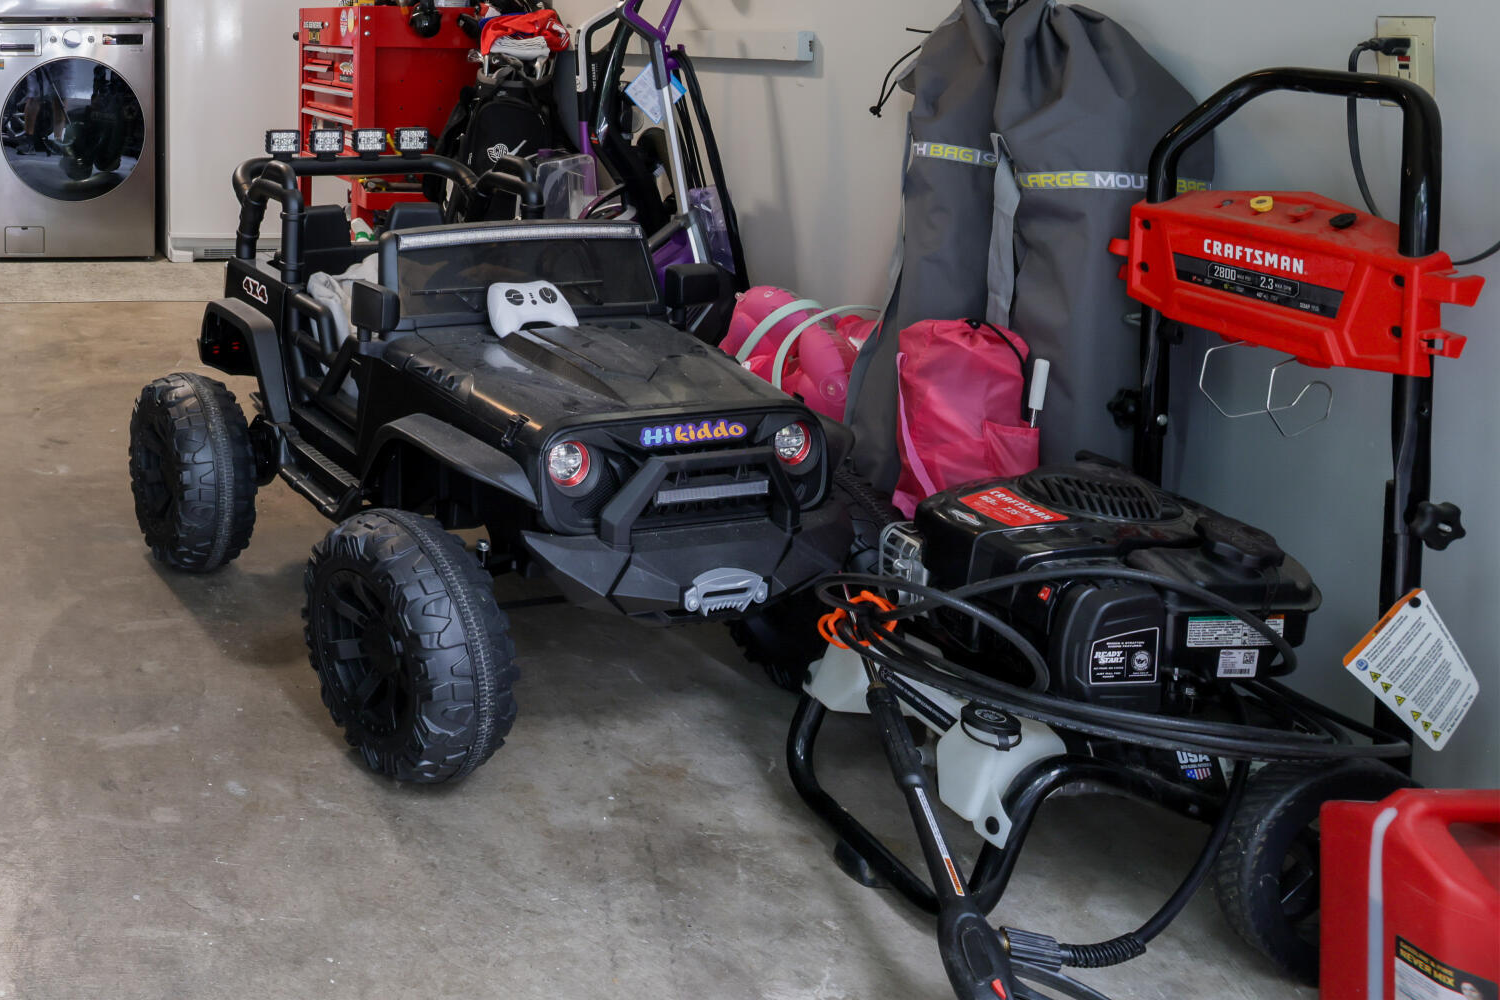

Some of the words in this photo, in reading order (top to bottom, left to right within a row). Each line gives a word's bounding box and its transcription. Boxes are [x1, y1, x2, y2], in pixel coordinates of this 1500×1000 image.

[929, 144, 974, 162] BAG
[1020, 172, 1090, 188] LARGE
[1203, 239, 1304, 275] CRAFTSMAN
[243, 276, 268, 304] 4X4
[1214, 266, 1236, 281] 2800
[1260, 276, 1274, 290] 2.3
[642, 420, 745, 446] Hikiddo
[989, 490, 1053, 520] CRAFTSMAN
[1093, 651, 1123, 660] READY
[1098, 657, 1125, 665] START
